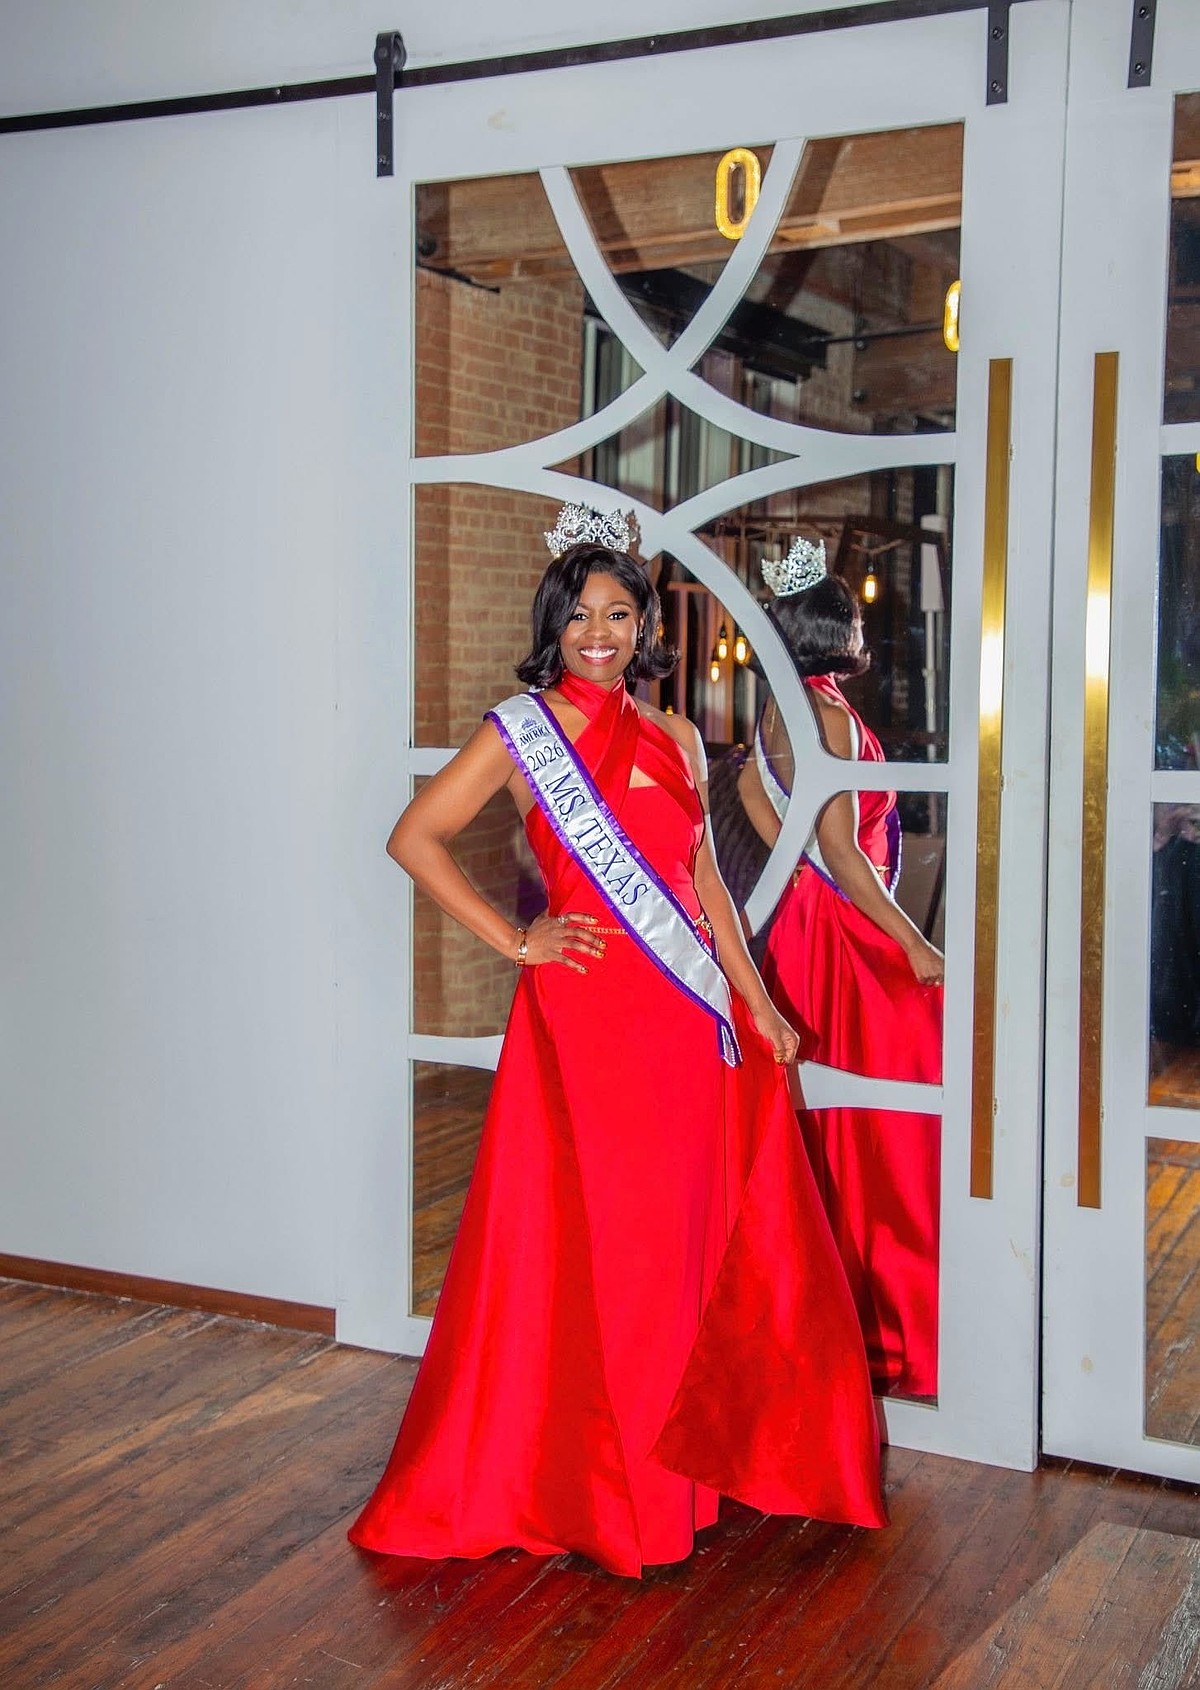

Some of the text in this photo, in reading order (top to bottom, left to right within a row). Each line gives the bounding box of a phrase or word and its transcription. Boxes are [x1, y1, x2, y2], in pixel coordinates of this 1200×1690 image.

[520, 726, 550, 746] AMERICA
[527, 740, 564, 772] 2026
[574, 817, 648, 906] TEXAS
